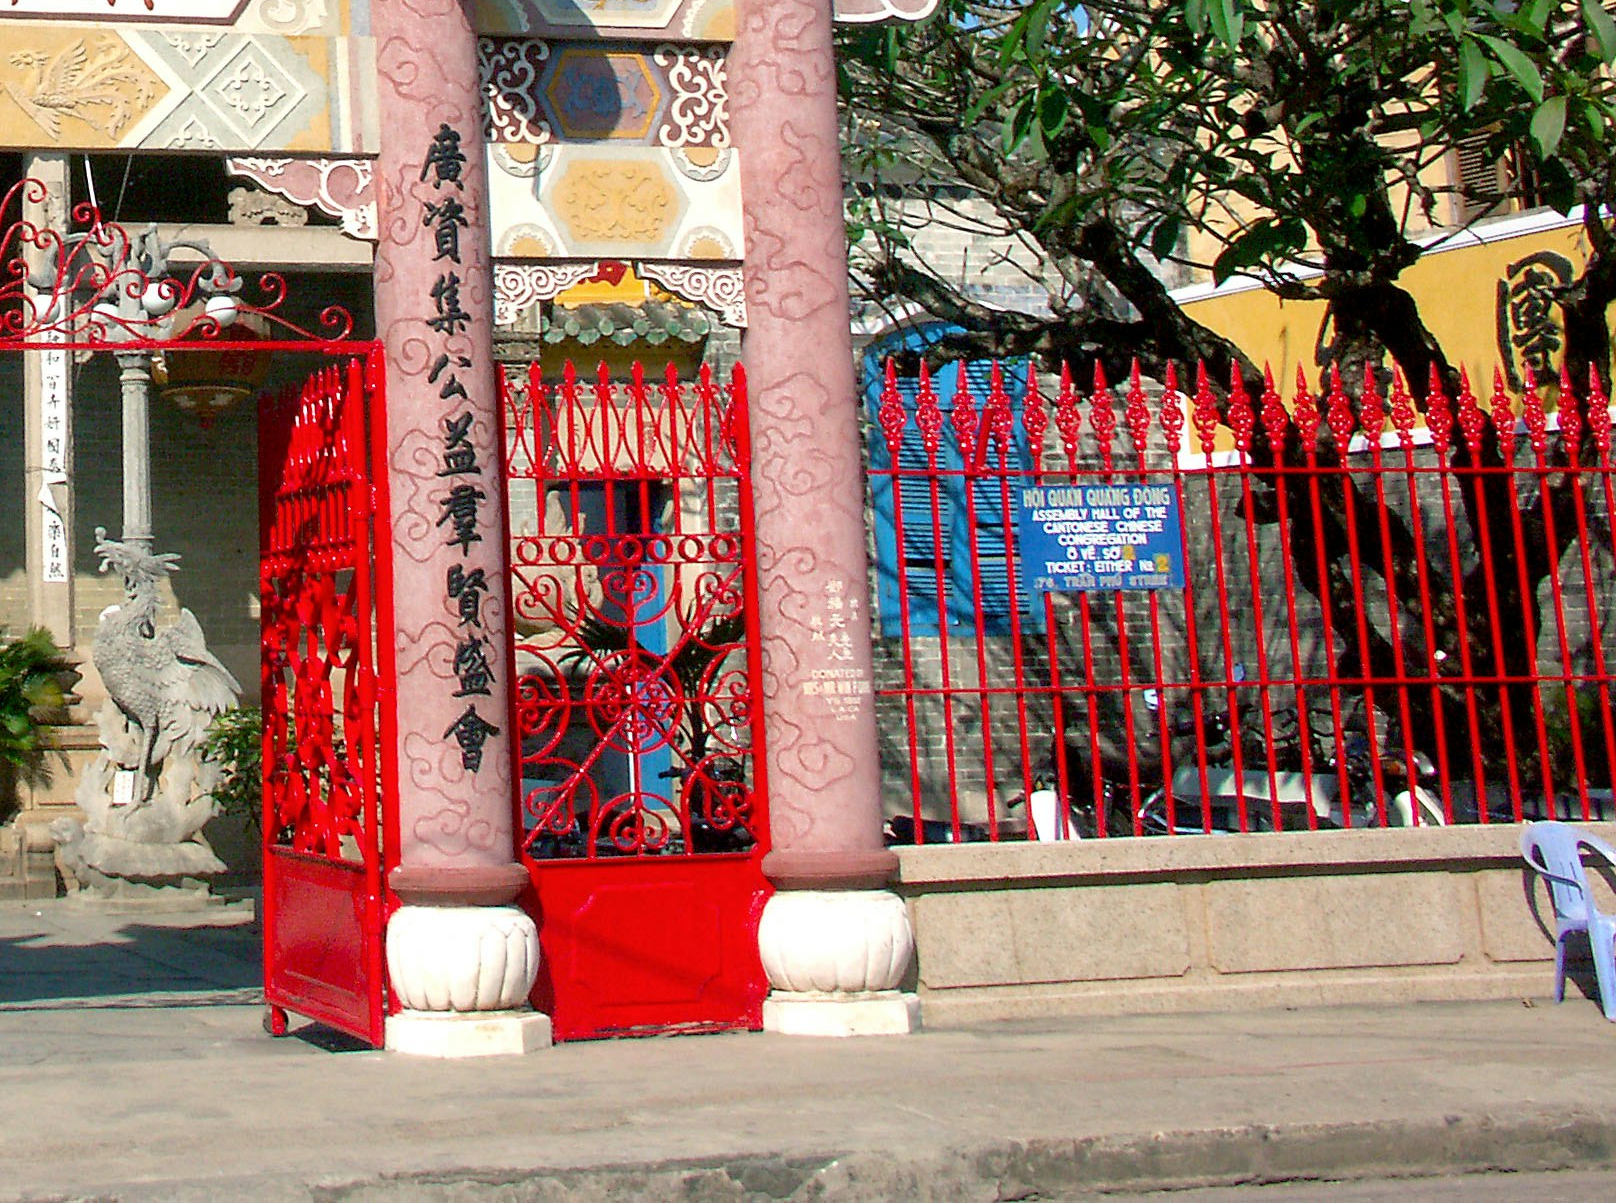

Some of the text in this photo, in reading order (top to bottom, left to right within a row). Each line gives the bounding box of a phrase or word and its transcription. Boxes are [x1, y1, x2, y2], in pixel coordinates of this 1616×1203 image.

[1032, 506, 1168, 521] ASSEMBLY HALL OF THE
[1042, 519, 1163, 534] CANTONESE CHINESE
[1057, 533, 1148, 546] CONGREGATION
[1094, 560, 1133, 573] EITHER
[1156, 554, 1170, 572] 2
